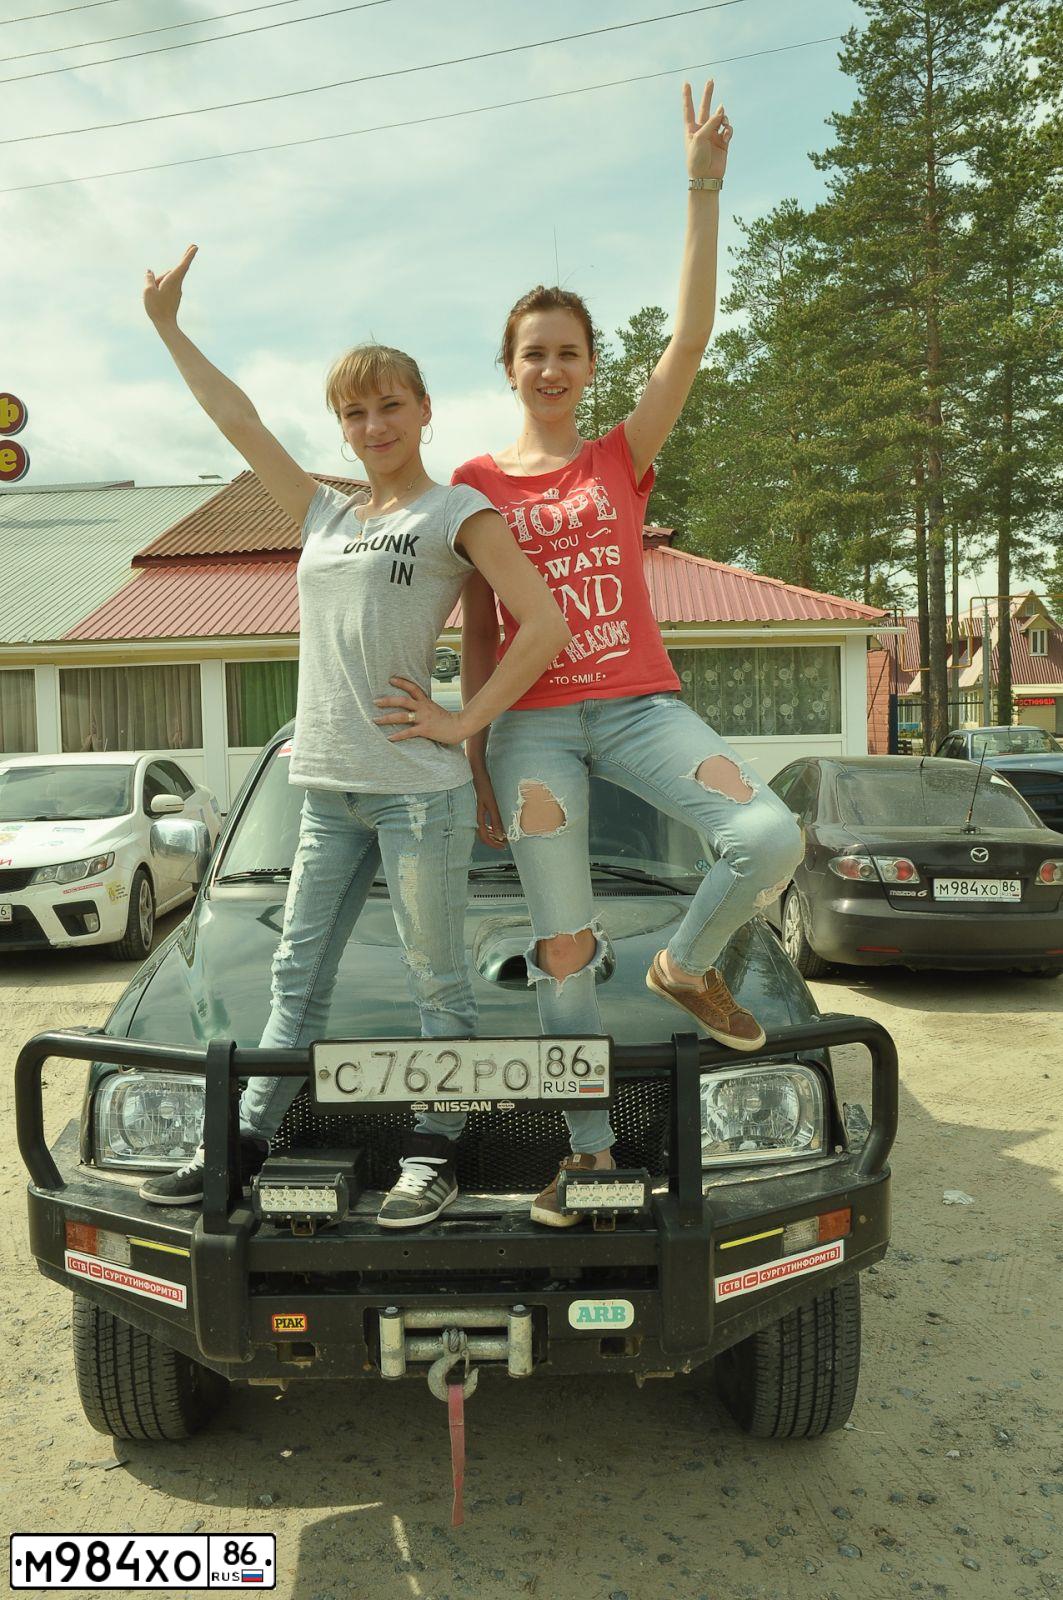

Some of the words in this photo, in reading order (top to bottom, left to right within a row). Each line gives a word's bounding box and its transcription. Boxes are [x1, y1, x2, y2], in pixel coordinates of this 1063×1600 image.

[550, 534, 579, 551] YOU
[535, 545, 621, 581] WAYS
[390, 560, 414, 586] IN
[554, 676, 570, 685] TO
[571, 672, 601, 684] SMILE
[1001, 881, 1017, 892] 86
[546, 1044, 592, 1078] 86
[543, 1081, 578, 1094] RUS
[434, 1101, 492, 1113] NISSAN
[577, 1306, 626, 1323] ARB
[274, 1318, 304, 1328] PIAK
